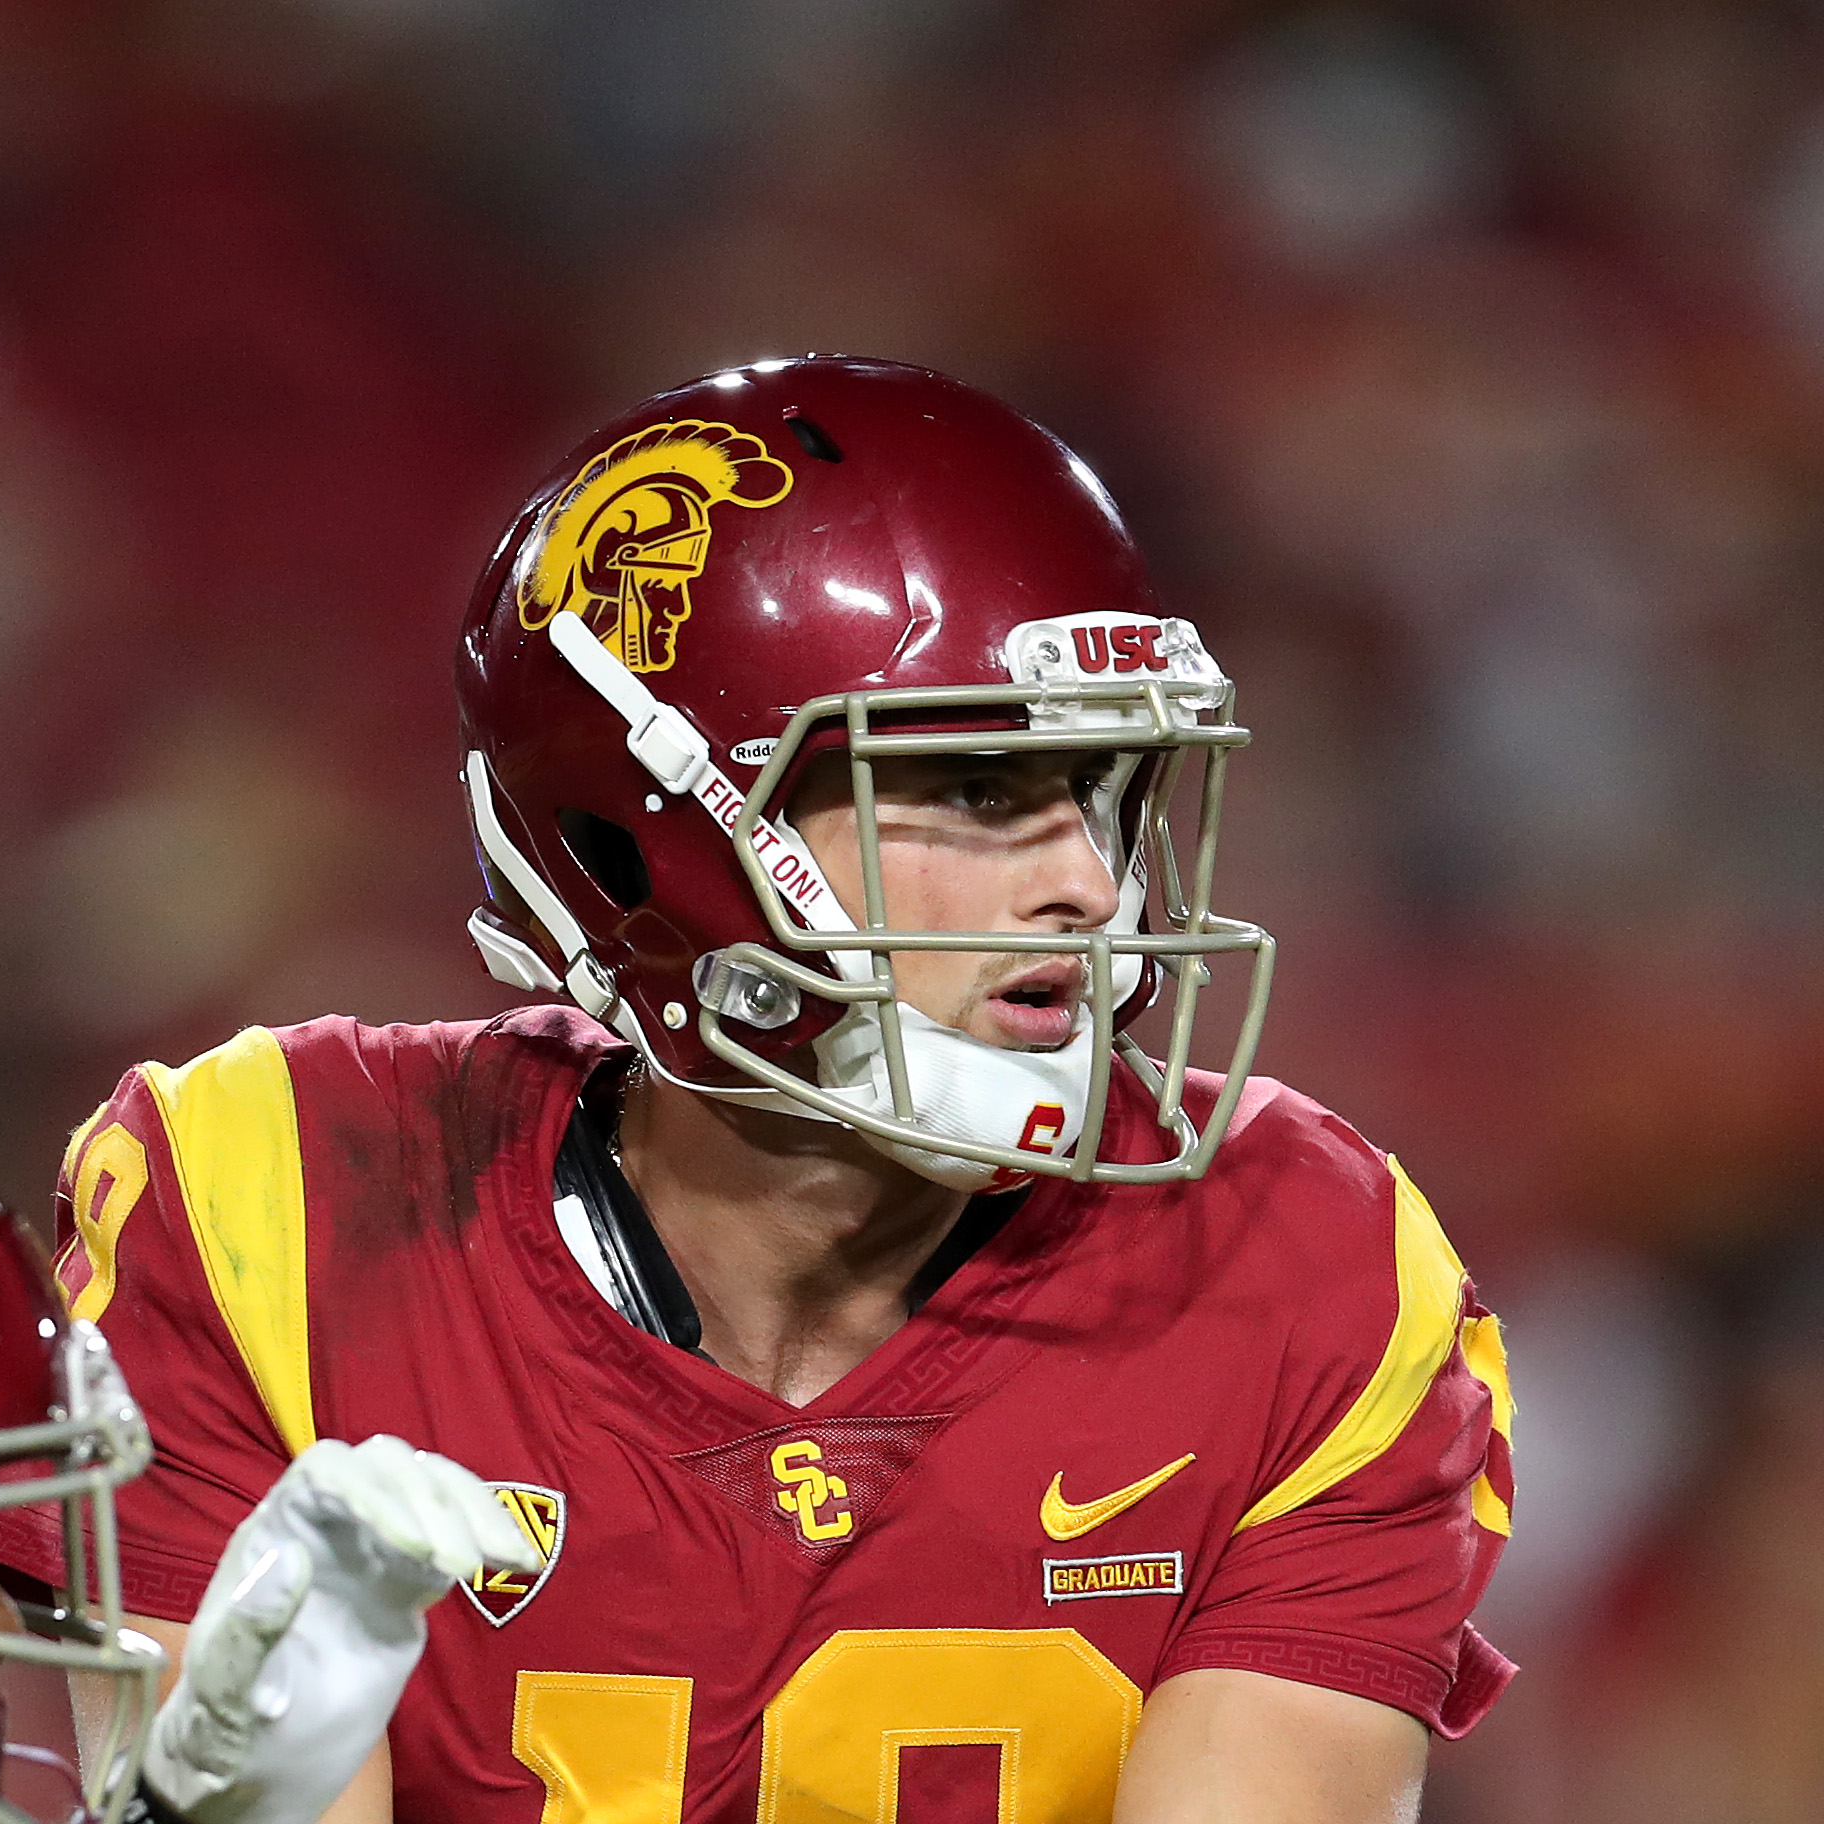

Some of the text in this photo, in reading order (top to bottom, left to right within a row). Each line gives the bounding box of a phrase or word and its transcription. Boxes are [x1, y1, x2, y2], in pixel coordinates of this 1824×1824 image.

[1070, 624, 1168, 674] USC
[771, 854, 825, 909] ON!
[770, 1440, 854, 1541] SC
[1051, 1561, 1176, 1592] GRADUATE
